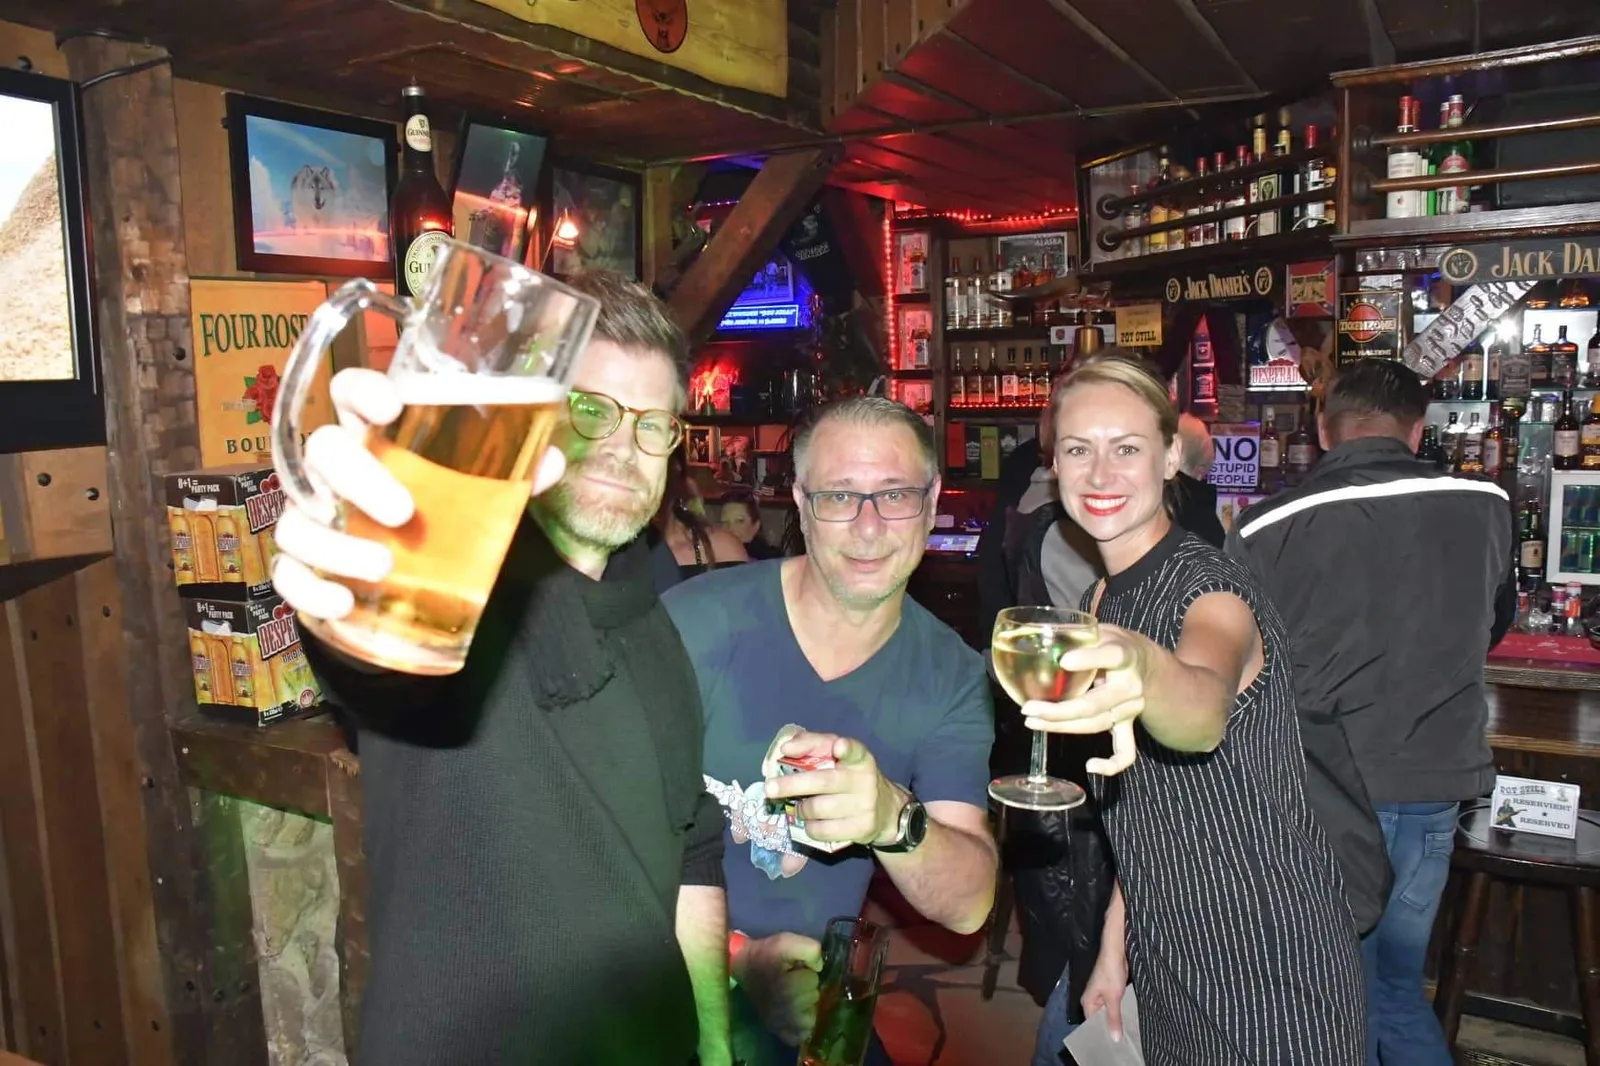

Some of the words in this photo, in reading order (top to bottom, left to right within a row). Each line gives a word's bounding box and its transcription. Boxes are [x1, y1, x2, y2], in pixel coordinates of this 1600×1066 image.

[1491, 246, 1554, 278] JACK
[1184, 276, 1210, 300] JACK
[1208, 269, 1252, 298] DANIEL'S
[200, 313, 262, 356] FOUR
[1120, 331, 1134, 343] POT
[1135, 330, 1157, 342] STILL
[1211, 437, 1257, 461] NO
[1210, 463, 1256, 474] STUPID
[1207, 474, 1256, 485] PEOPLE
[191, 485, 207, 493] PARTY
[207, 484, 221, 493] PACK
[208, 610, 222, 619] PARTY
[222, 611, 234, 619] PACK
[1500, 786, 1517, 794] POT
[1519, 785, 1546, 794] STILL
[1512, 798, 1573, 812] RESERVIERT
[1519, 817, 1571, 830] RESERVED
